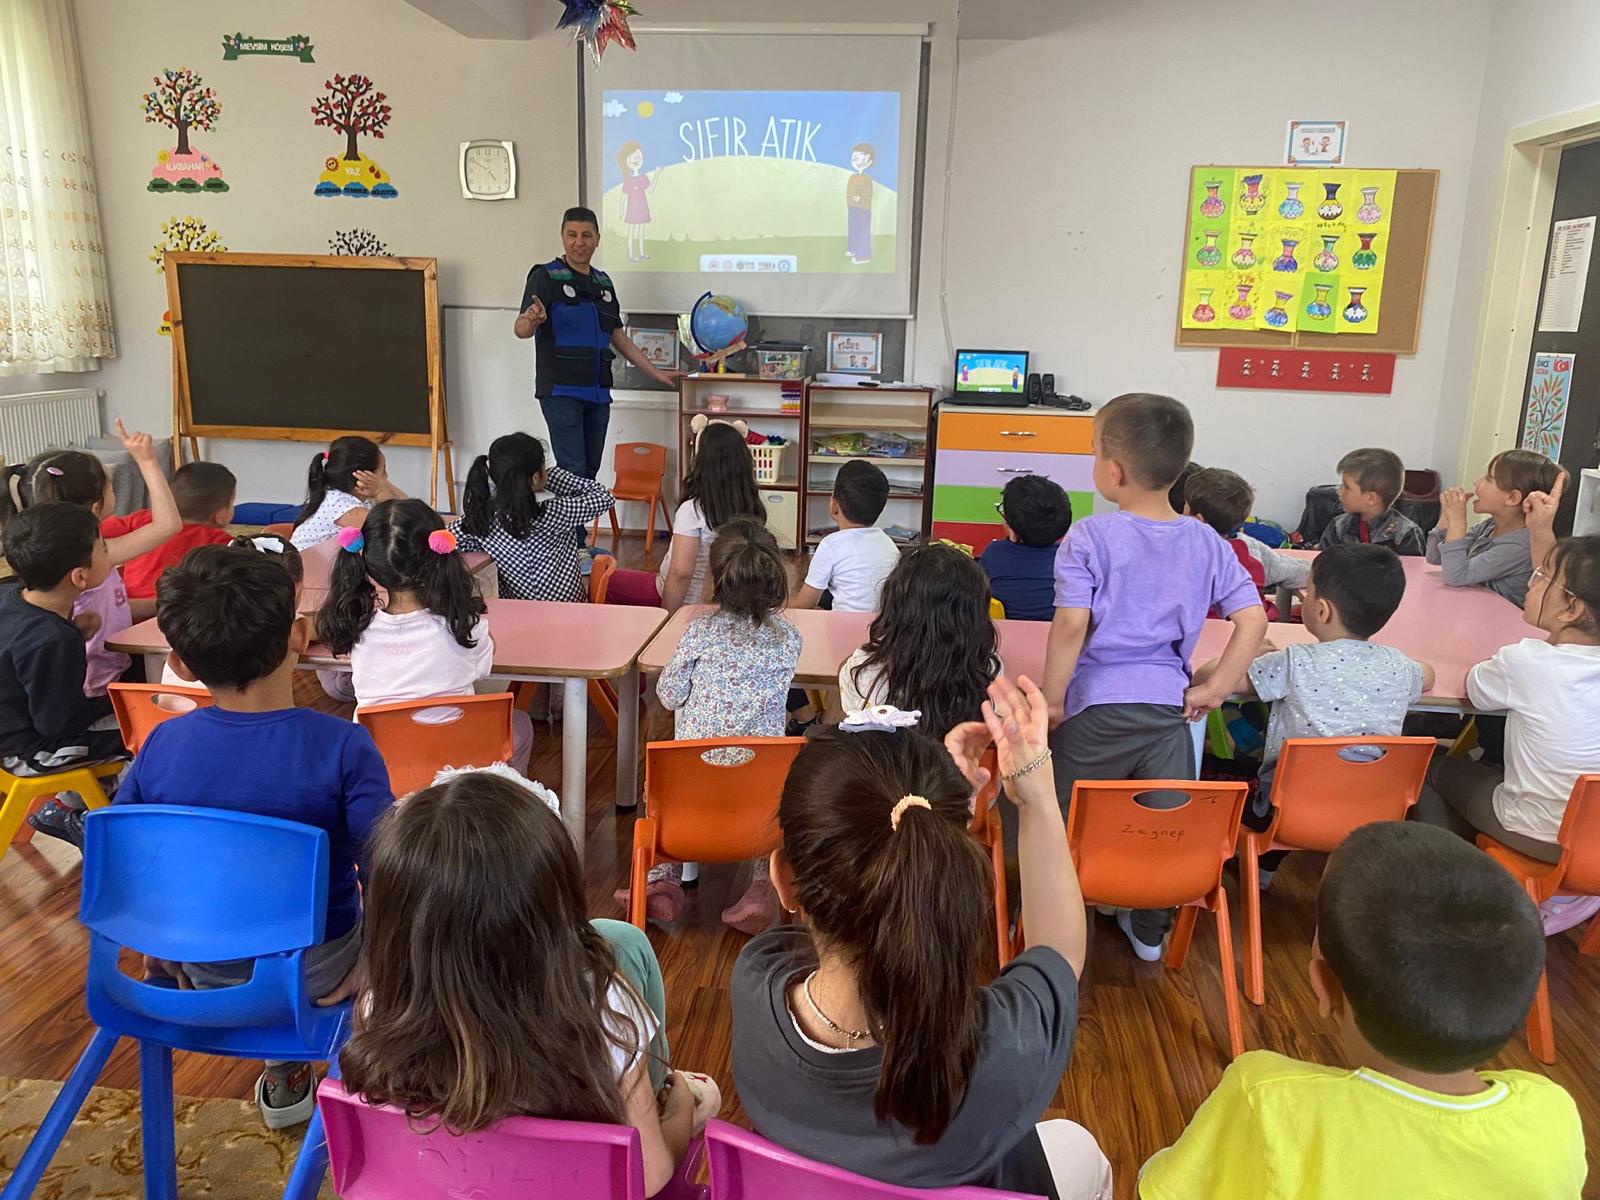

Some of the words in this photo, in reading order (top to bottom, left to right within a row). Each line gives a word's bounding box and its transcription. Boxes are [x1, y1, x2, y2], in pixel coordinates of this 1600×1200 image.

[679, 116, 749, 163] SIFIR
[760, 115, 822, 163] ATIK
[344, 167, 361, 177] YAZ
